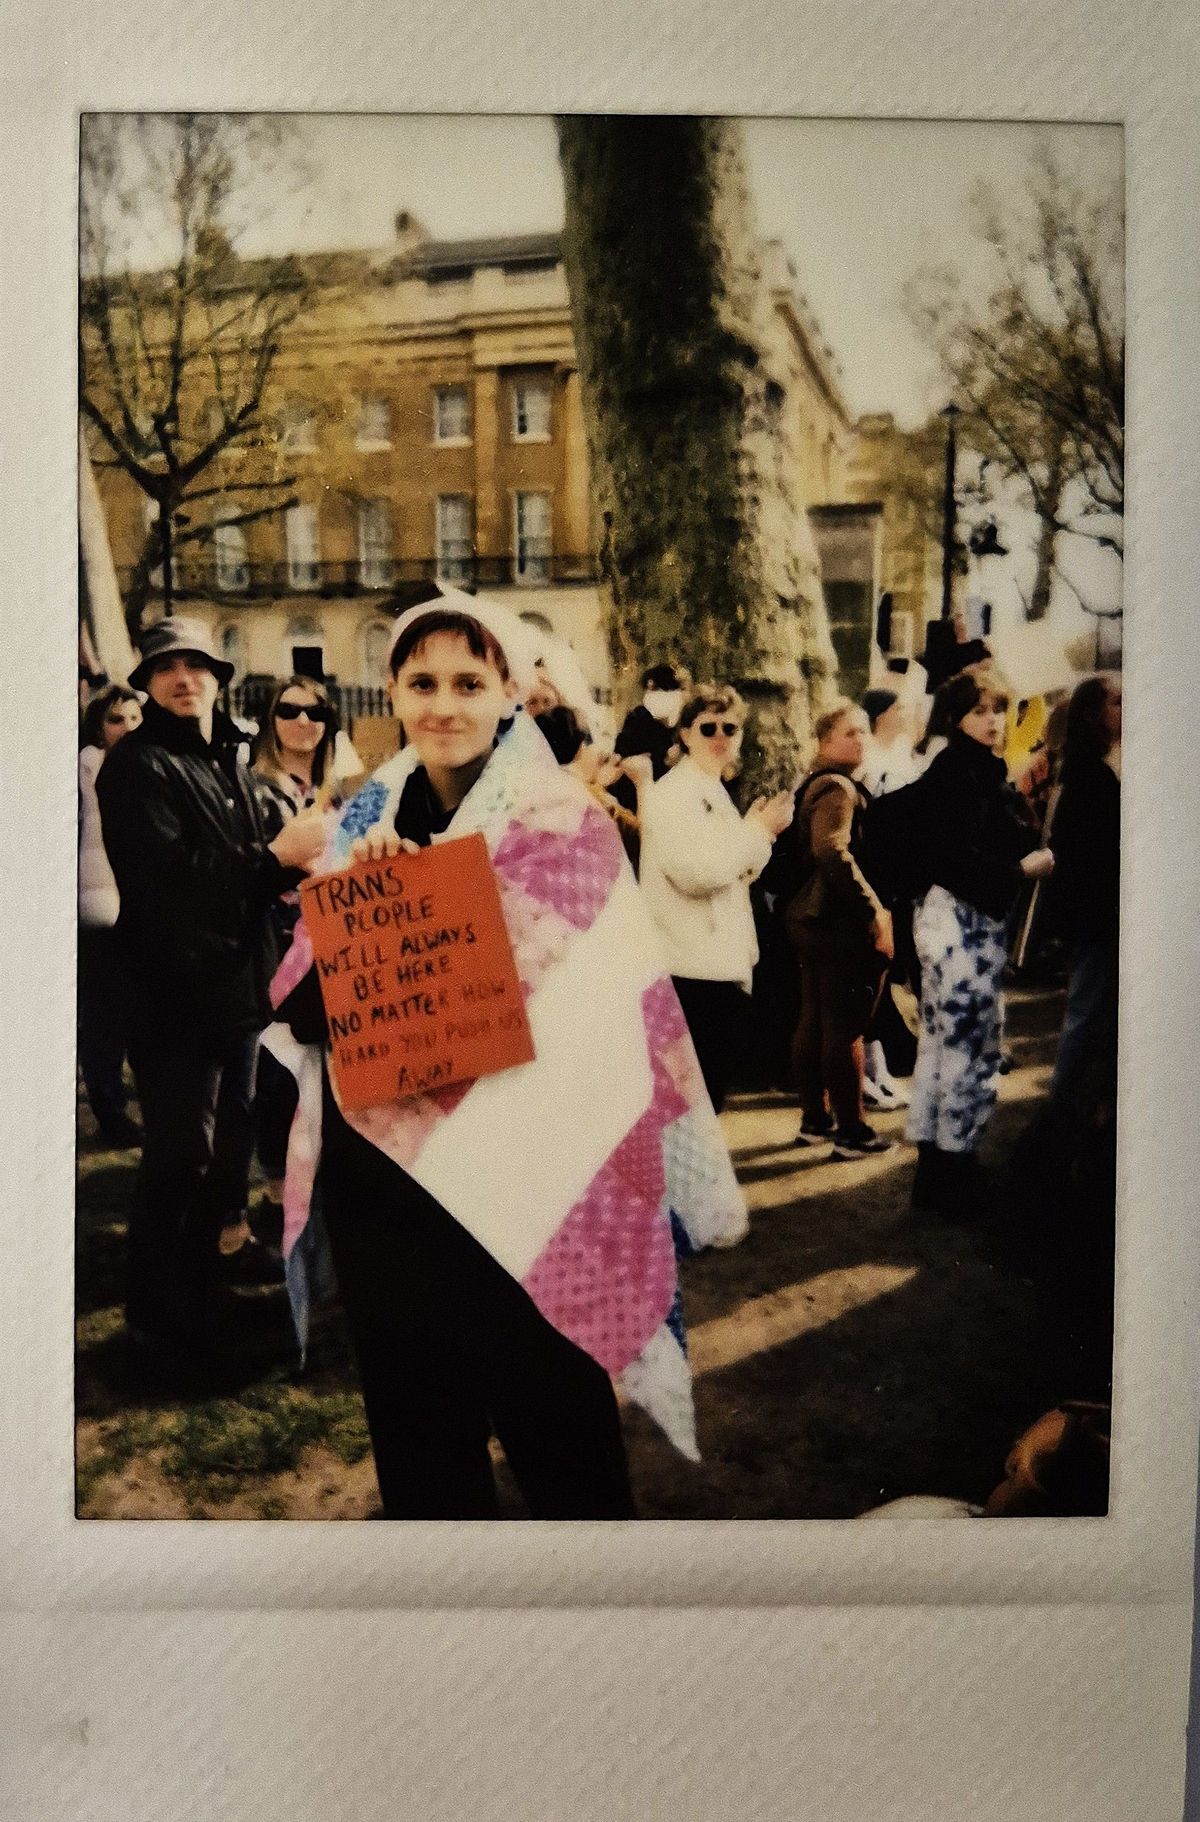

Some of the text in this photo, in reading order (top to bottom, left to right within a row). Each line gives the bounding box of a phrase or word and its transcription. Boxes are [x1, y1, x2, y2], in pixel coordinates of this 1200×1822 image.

[308, 867, 404, 917] TRANS
[343, 894, 433, 937] PEOPLE
[315, 923, 475, 977] WILL ALWAYS
[353, 955, 452, 1001] BE HERE
[330, 980, 505, 1039] NO MATTER HOW
[340, 1043, 391, 1068] HARD
[398, 1060, 454, 1091] AWAY
